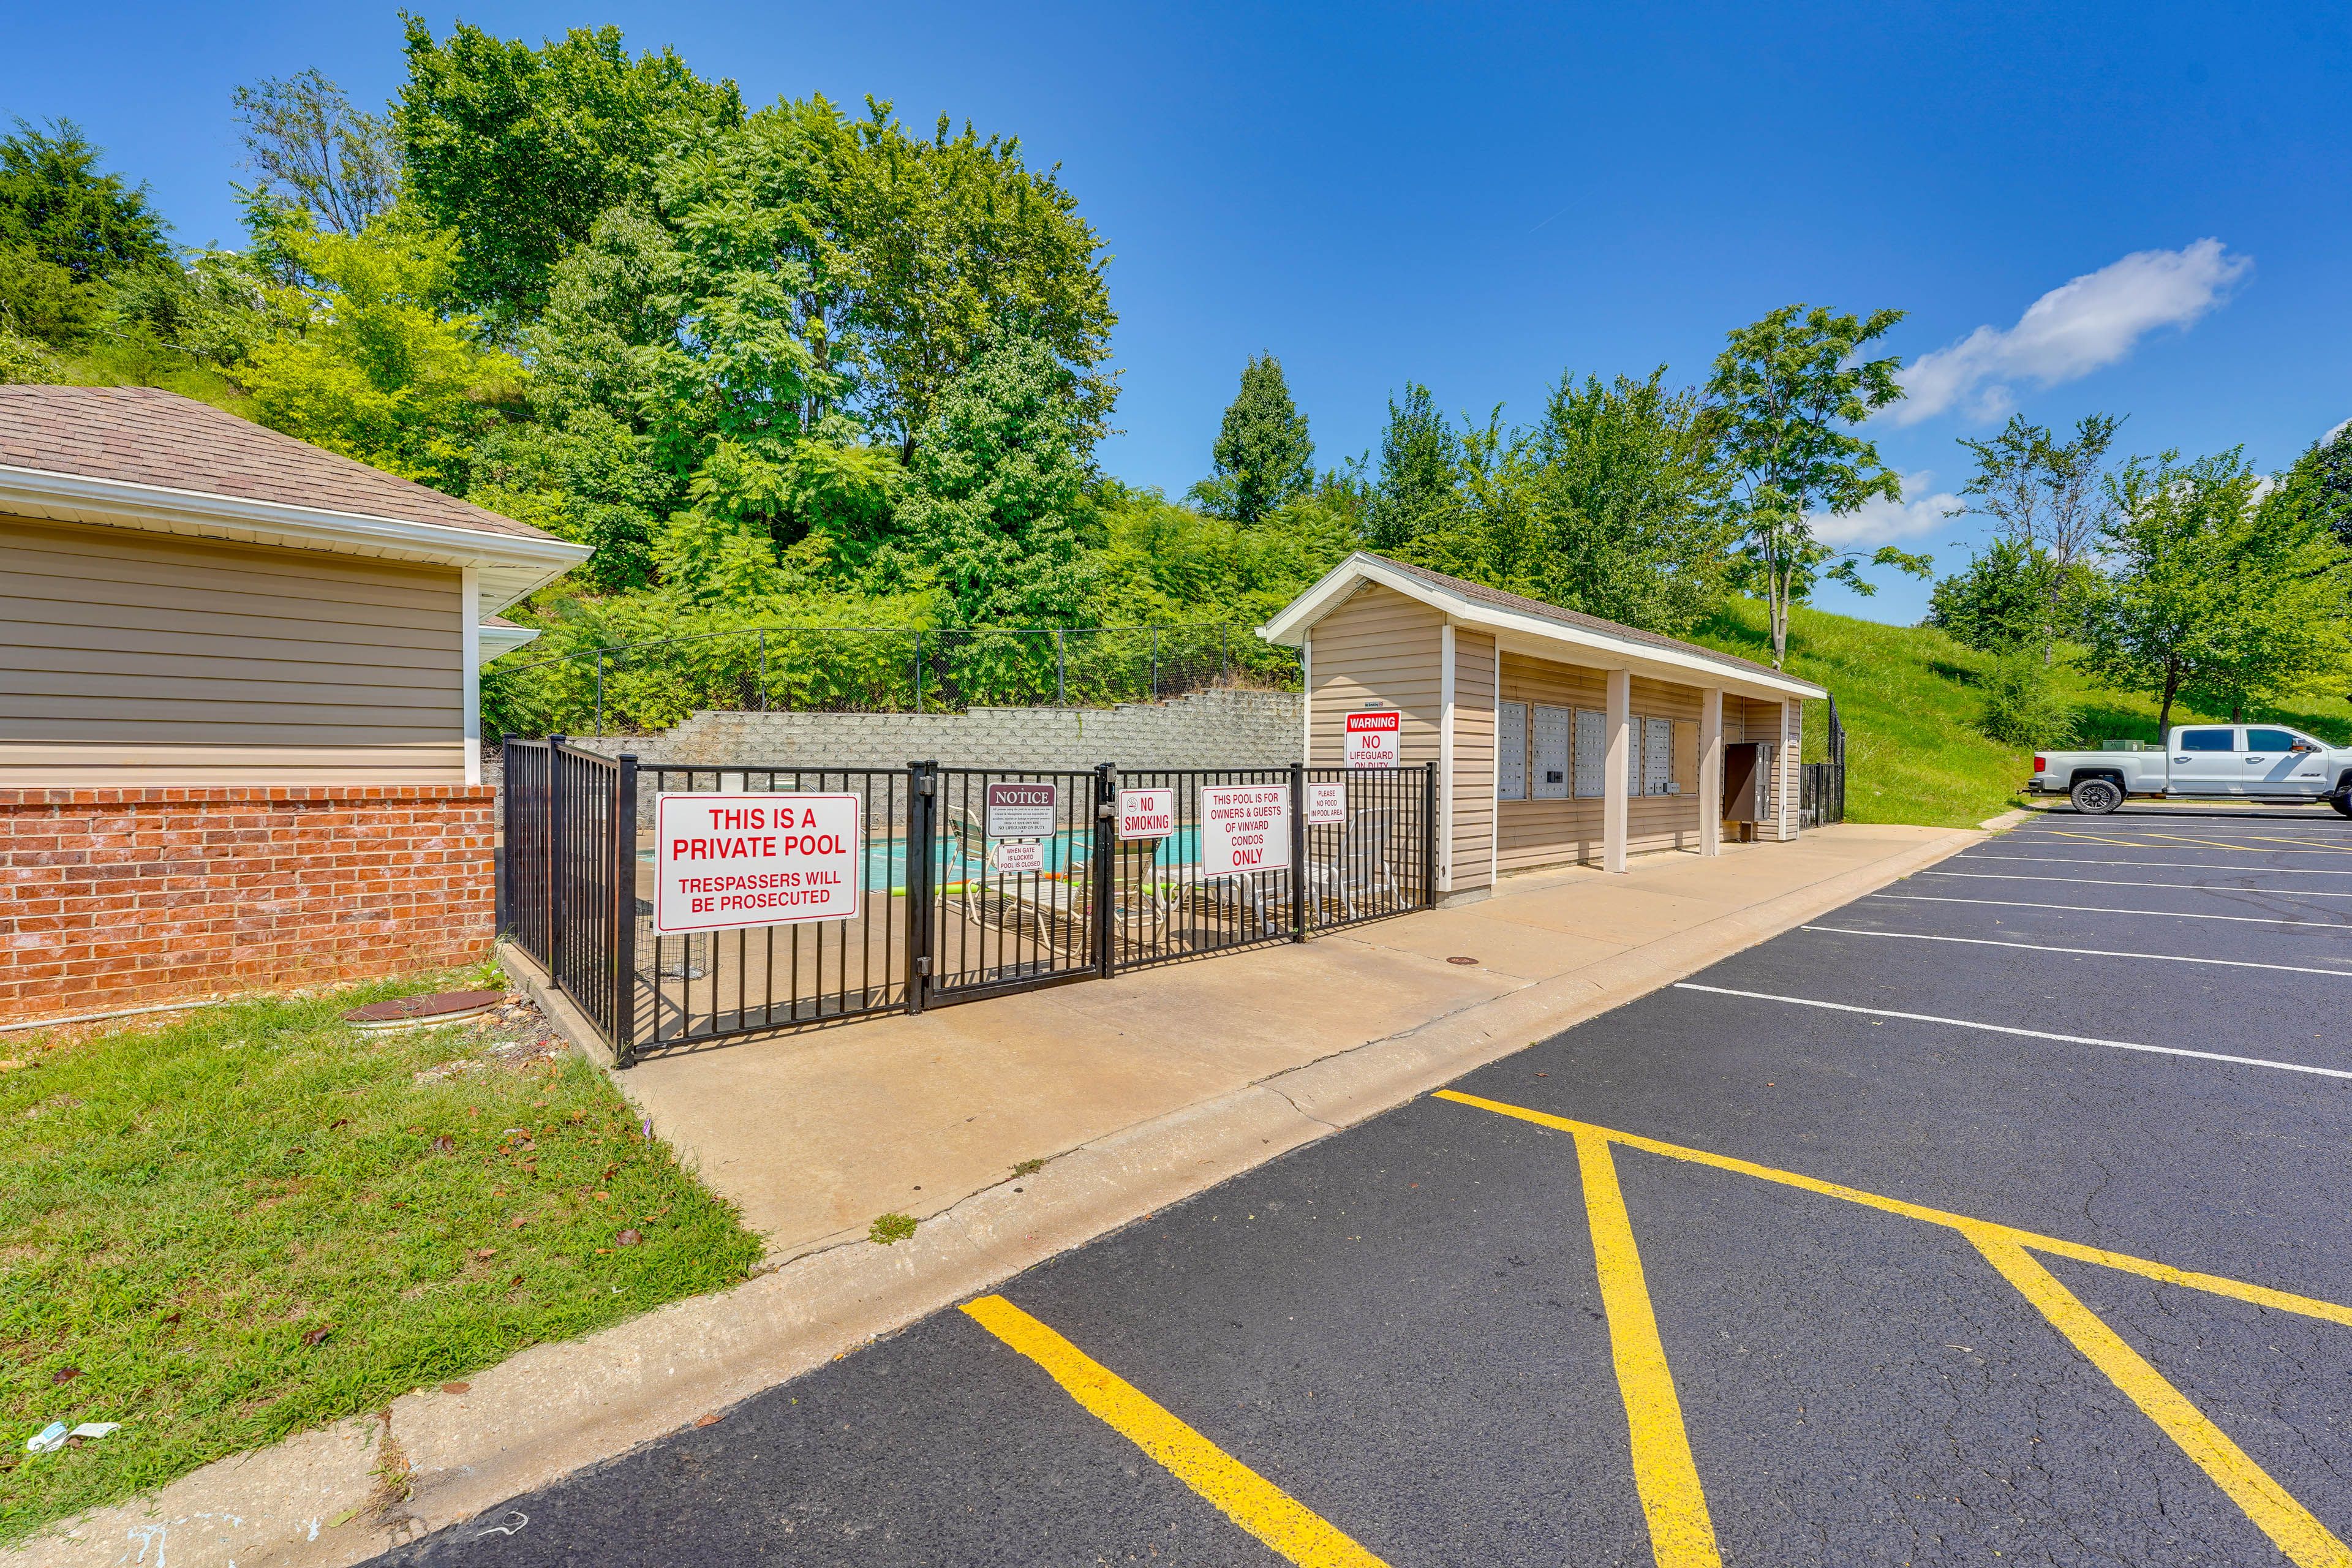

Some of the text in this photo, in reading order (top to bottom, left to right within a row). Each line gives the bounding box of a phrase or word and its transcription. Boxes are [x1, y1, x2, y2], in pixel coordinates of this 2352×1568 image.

[1350, 717, 1395, 728] WARNING
[1362, 735, 1381, 748] NO
[1350, 751, 1393, 760] LIFEGUARD
[995, 791, 1049, 804] NOTICE
[1140, 797, 1153, 812] NO
[1213, 793, 1278, 805] THIS POOL IS FOR
[709, 808, 817, 830] THIS IS A
[1211, 806, 1281, 820] OWNERS & GUESTS
[1125, 815, 1169, 831] SMOKING
[1225, 820, 1268, 833] OF VINYARD
[1231, 834, 1264, 846] CONDOS
[673, 834, 846, 861] PRIVATE POOL
[1232, 848, 1263, 866] ONLY
[679, 870, 841, 894] TRESPASSERS WILL
[692, 889, 830, 913] BE PROSECUTED
